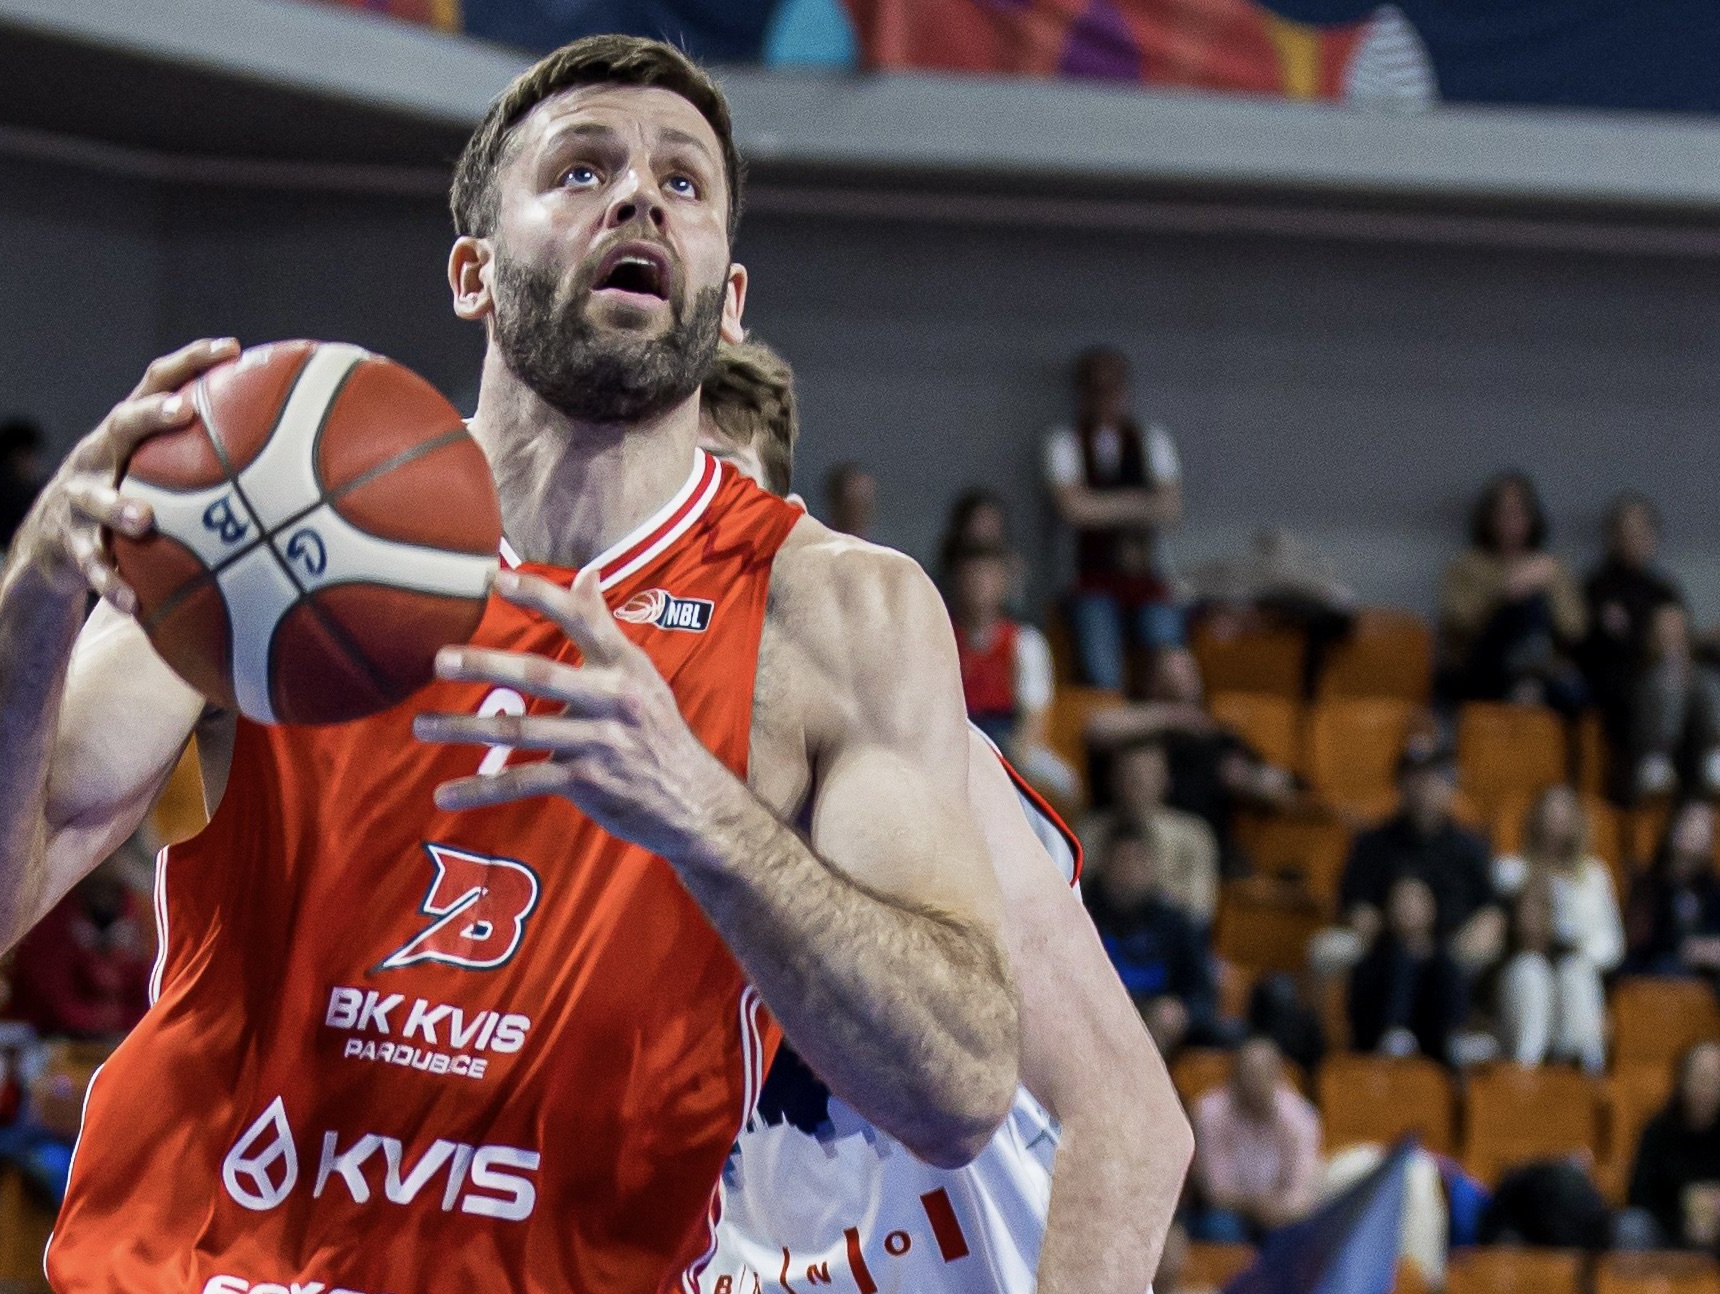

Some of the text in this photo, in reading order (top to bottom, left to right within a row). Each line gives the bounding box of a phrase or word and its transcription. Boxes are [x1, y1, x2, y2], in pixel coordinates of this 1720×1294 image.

[666, 602, 701, 628] NBL
[326, 986, 531, 1053] BK KVIS
[344, 1037, 488, 1079] PARDUBCE
[313, 1130, 541, 1222] KVIS
